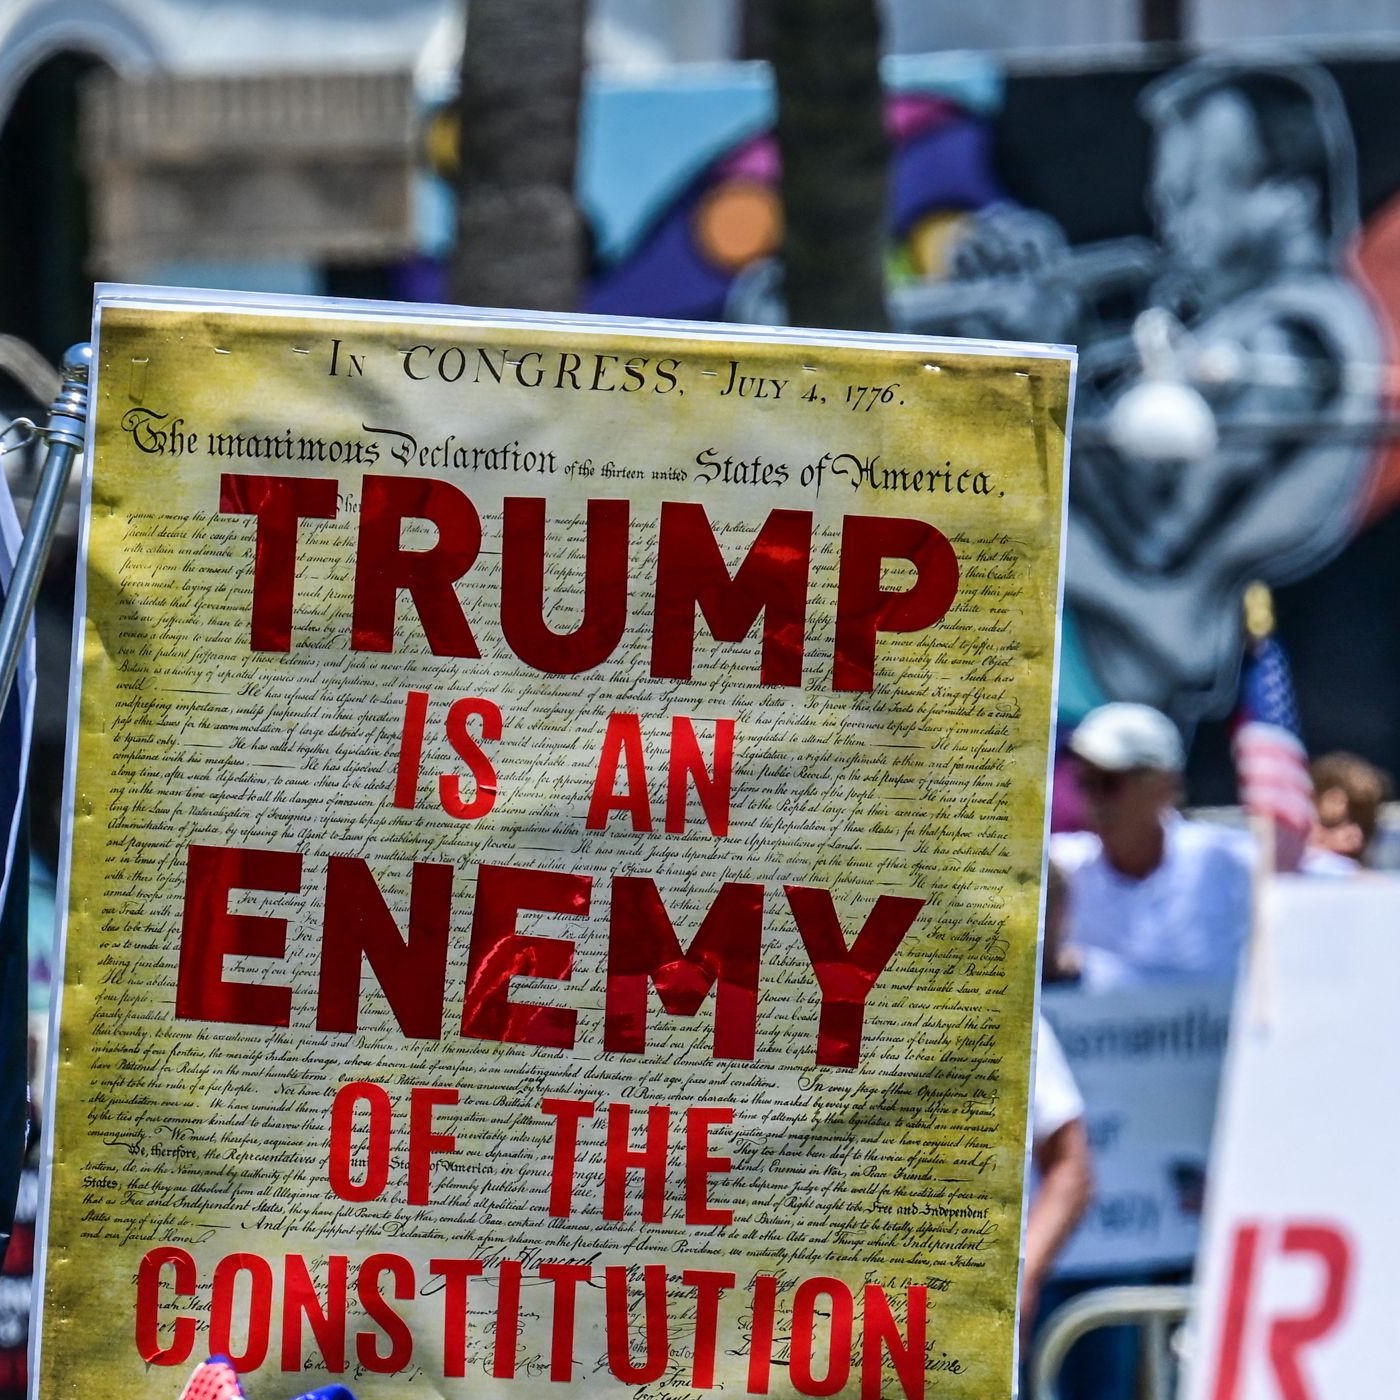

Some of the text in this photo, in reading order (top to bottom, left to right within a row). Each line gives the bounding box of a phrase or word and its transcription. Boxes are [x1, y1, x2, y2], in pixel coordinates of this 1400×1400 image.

[401, 340, 687, 398] CONGRESS,
[800, 383, 826, 404] 4,
[845, 383, 904, 412] 1776.
[120, 407, 199, 457] The
[207, 428, 381, 468] unanimous
[362, 425, 558, 478] Declaration
[600, 460, 644, 480] thirteen
[651, 467, 688, 482] united
[693, 447, 790, 487] States
[800, 452, 833, 499] of
[831, 453, 1005, 499] America.
[220, 472, 959, 693] TRUMP
[395, 691, 735, 836] IS AN
[173, 844, 928, 1069] ENEMY
[327, 1079, 736, 1228] OF THE
[862, 1199, 990, 1225] Free and Independent
